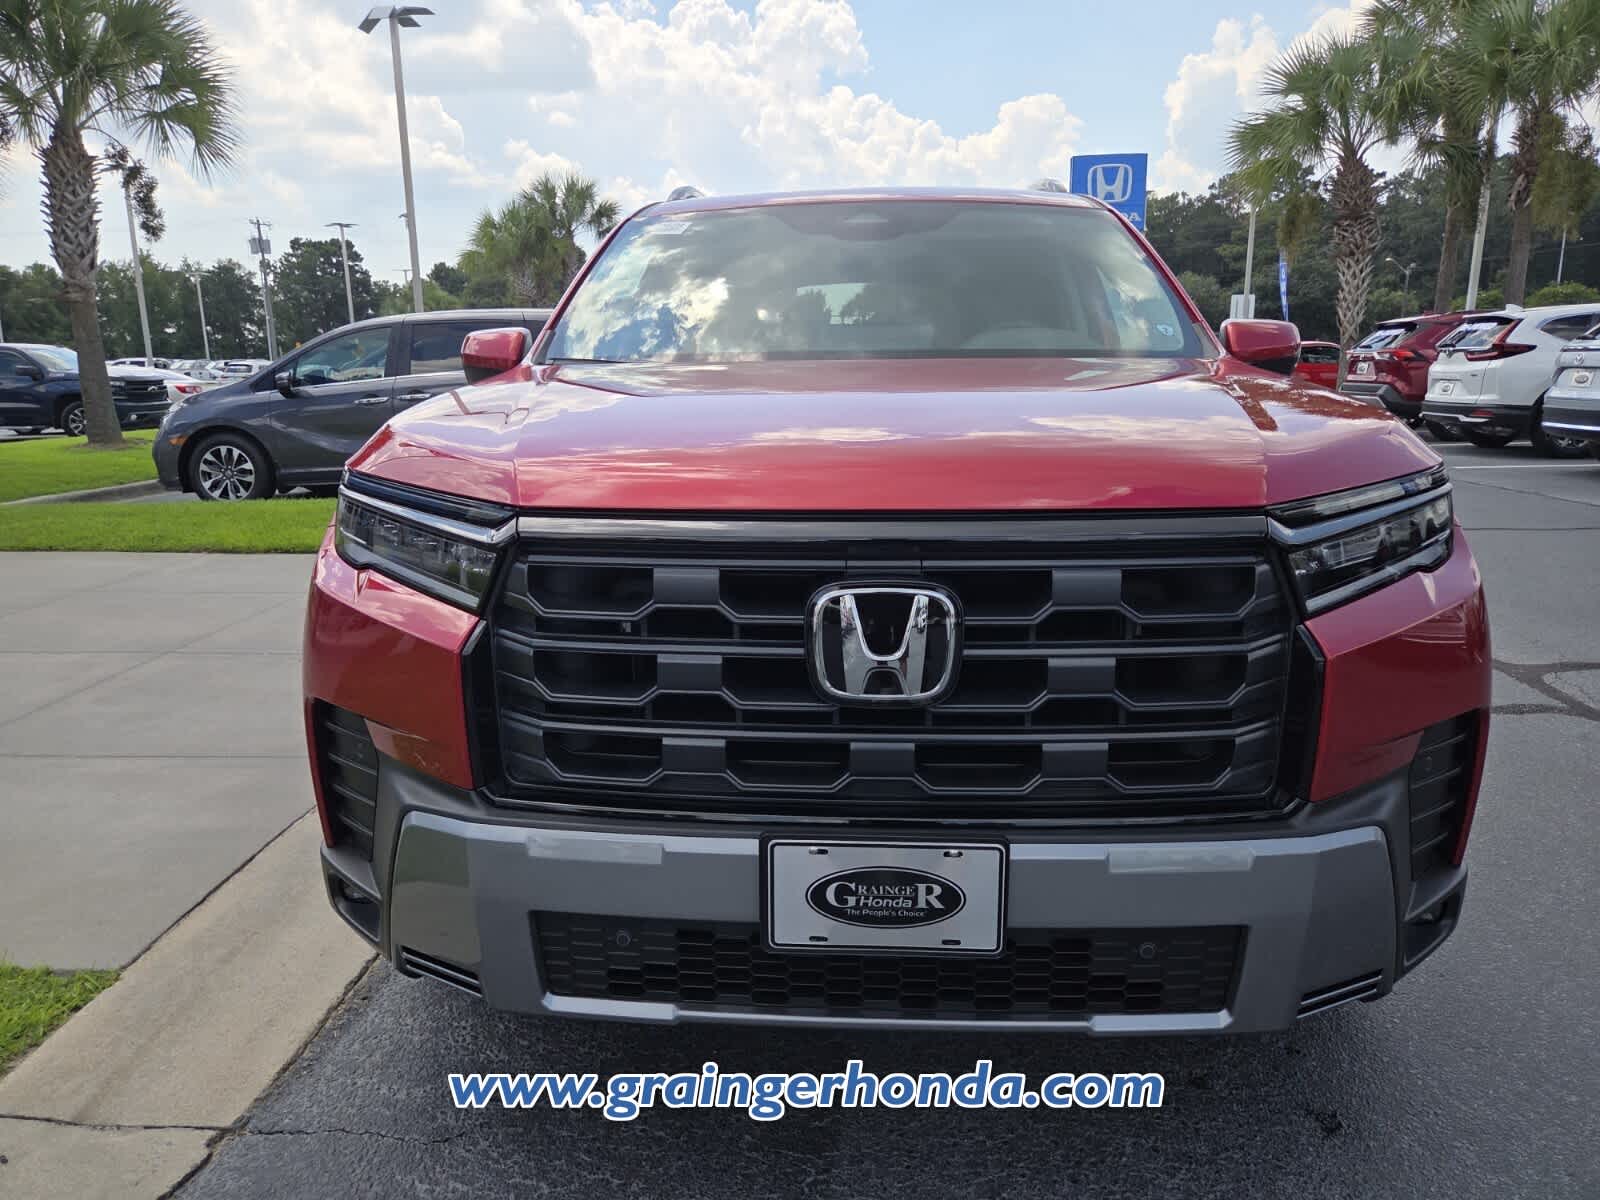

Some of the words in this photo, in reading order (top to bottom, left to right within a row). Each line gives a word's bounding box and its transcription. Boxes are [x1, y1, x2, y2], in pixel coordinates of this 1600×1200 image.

[825, 881, 945, 909] GRAINGER
[860, 896, 913, 908] Honda
[846, 908, 860, 916] The
[862, 908, 897, 918] People's
[897, 909, 925, 917] Choice
